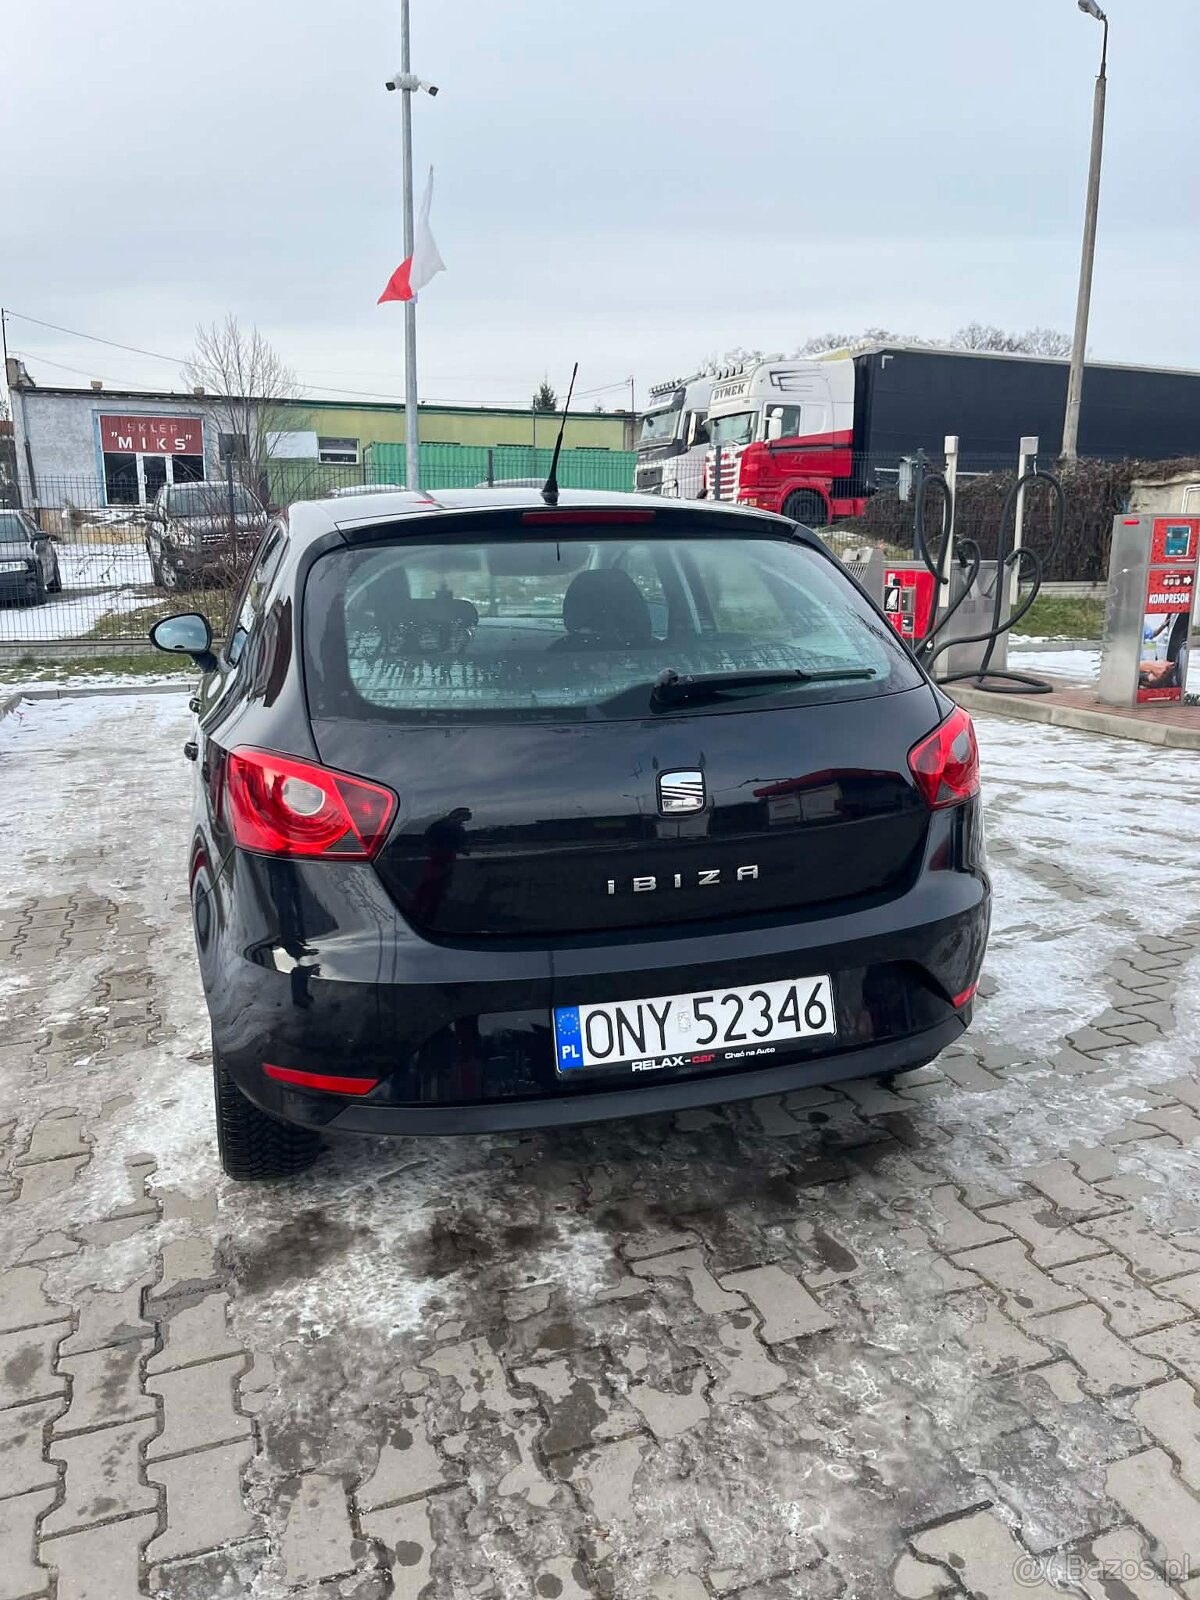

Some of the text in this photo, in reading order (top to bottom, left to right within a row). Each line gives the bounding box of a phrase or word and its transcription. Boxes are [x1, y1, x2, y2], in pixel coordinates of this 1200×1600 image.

[714, 383, 745, 400] DYMEK
[1149, 593, 1190, 604] KOMPRESOR
[585, 1001, 672, 1058] ONY
[693, 983, 827, 1045] 52346
[562, 1045, 580, 1059] PL
[756, 1047, 776, 1056] Auto
